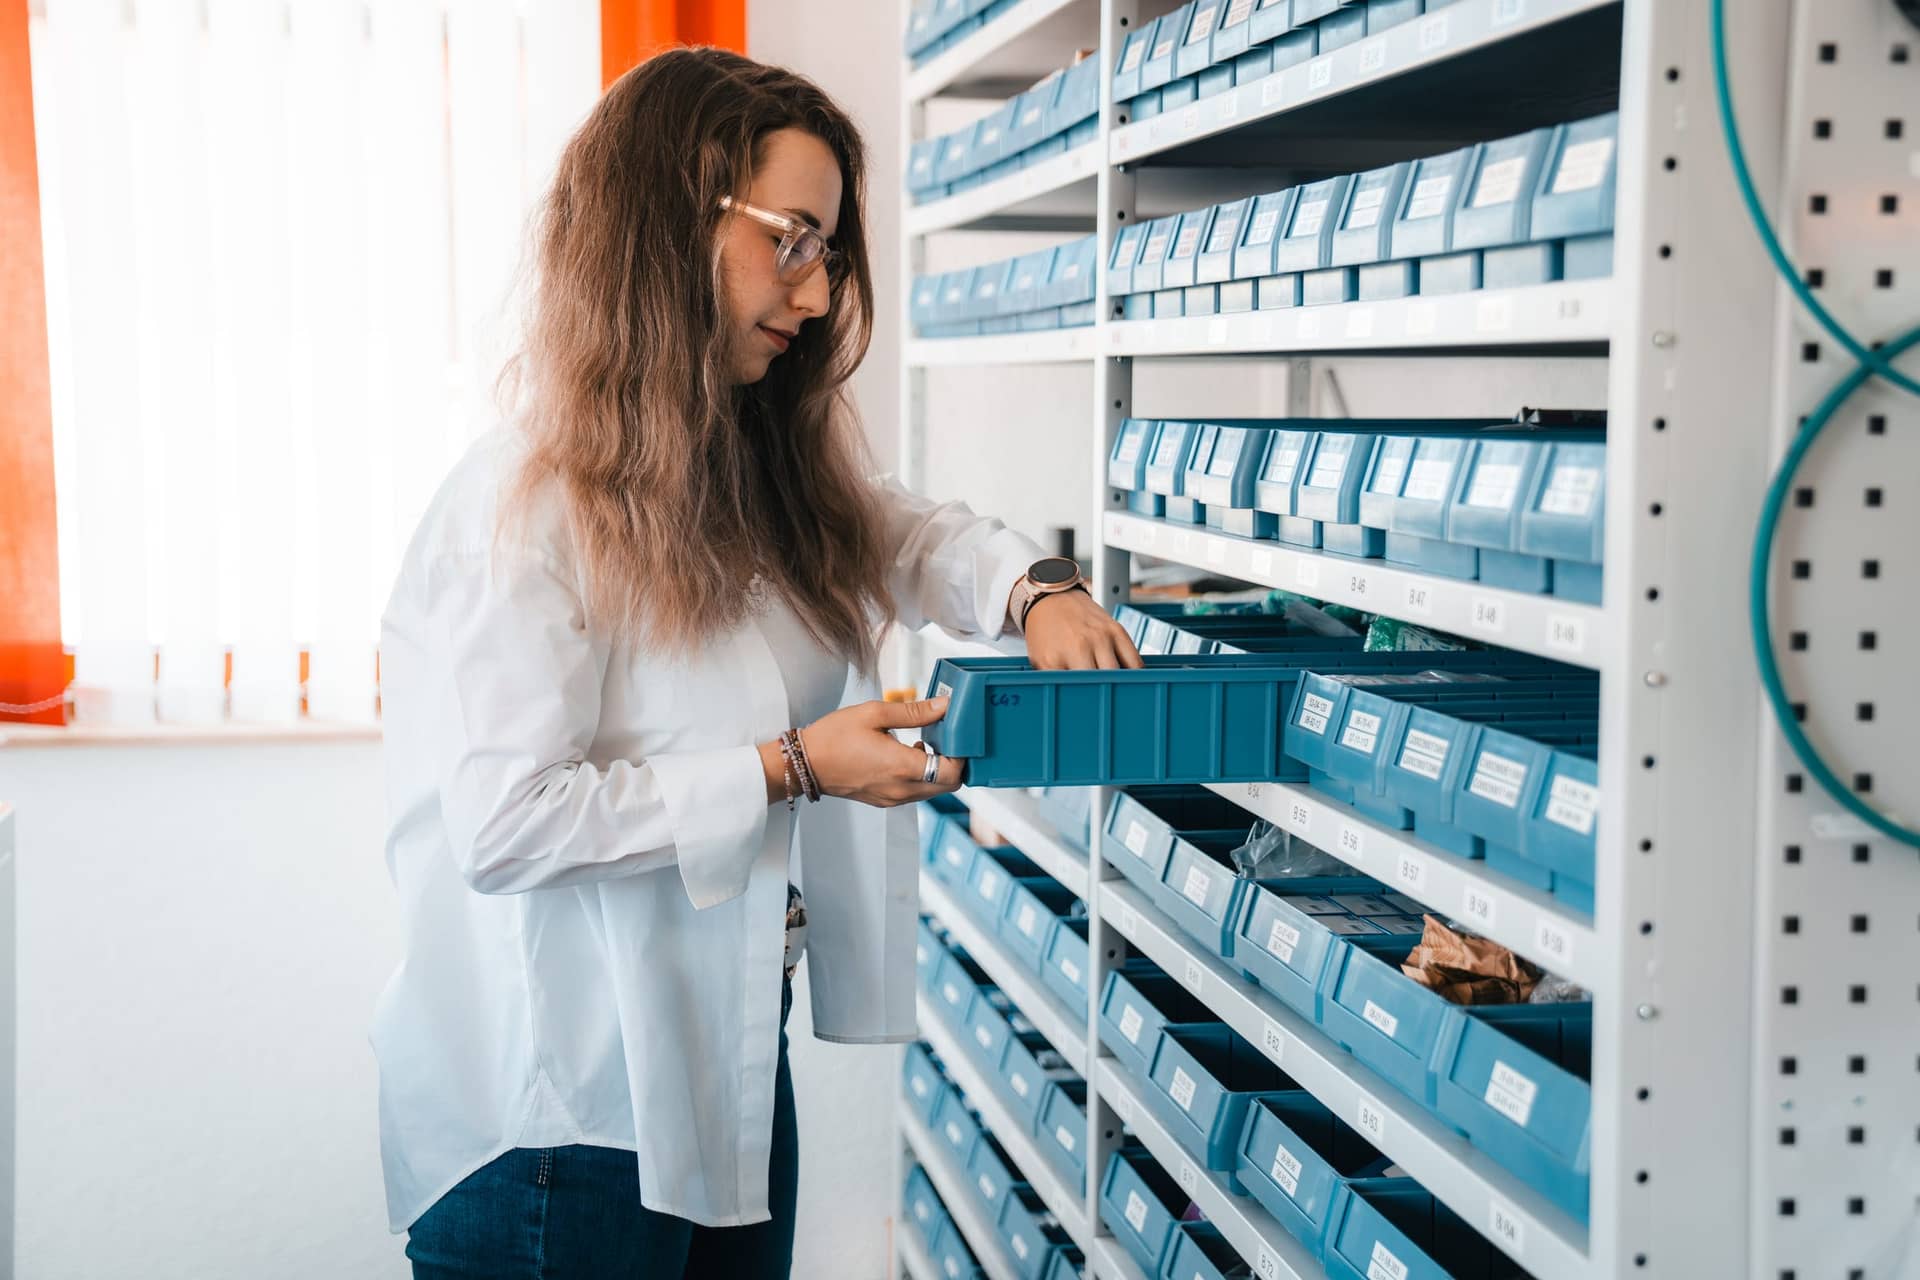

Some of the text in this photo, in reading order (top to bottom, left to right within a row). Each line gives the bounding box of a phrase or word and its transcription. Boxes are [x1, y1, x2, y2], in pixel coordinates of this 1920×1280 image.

[1357, 577, 1366, 594] 46
[1416, 591, 1426, 608] 47
[1299, 809, 1307, 824] 55
[1350, 834, 1359, 851] 56
[1409, 864, 1419, 881] 57
[1272, 1035, 1280, 1052] 62
[1370, 1114, 1378, 1132] 63
[1504, 1218, 1515, 1241] 64
[1267, 1260, 1275, 1279] 72
